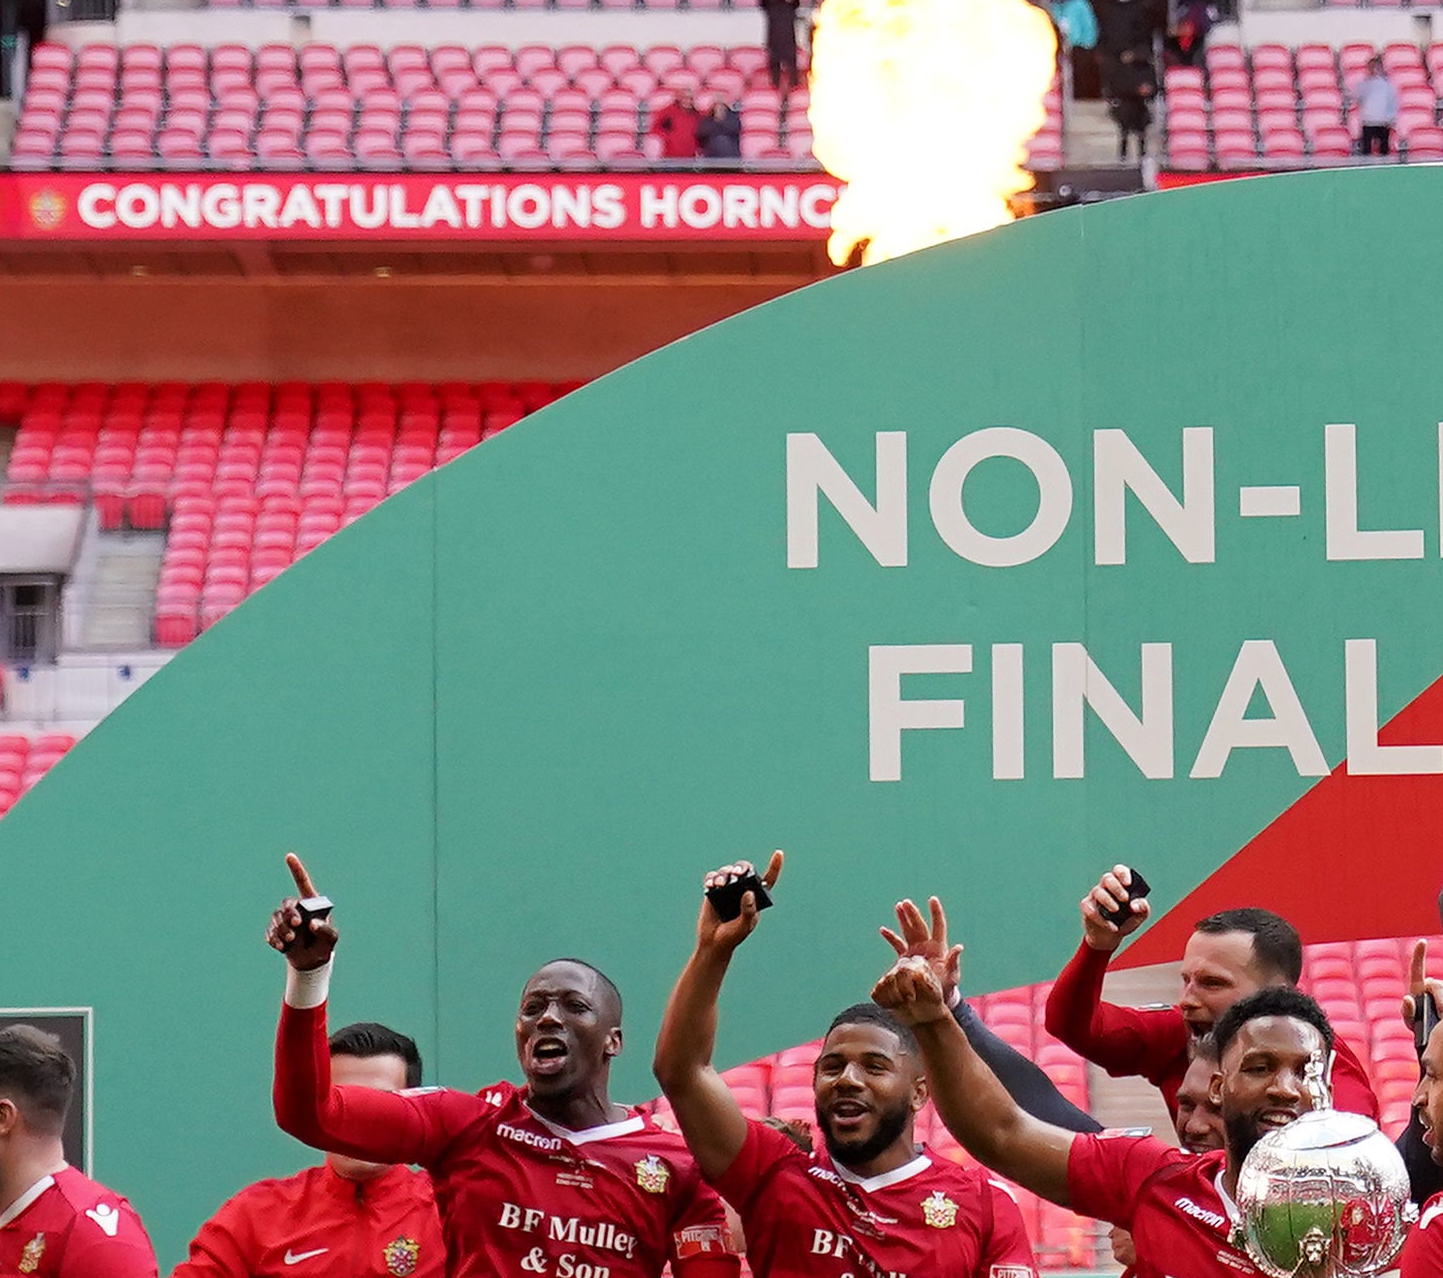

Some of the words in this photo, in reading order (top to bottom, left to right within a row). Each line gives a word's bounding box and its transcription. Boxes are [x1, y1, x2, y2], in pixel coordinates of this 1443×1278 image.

[77, 182, 626, 230] CONGRATULATIONS
[639, 183, 851, 230] HORNC
[496, 1122, 562, 1151] macron
[1174, 1197, 1226, 1229] macron
[498, 1201, 545, 1234] BF
[548, 1214, 640, 1260] Mulley
[810, 1227, 854, 1260] BF
[520, 1246, 547, 1275] &
